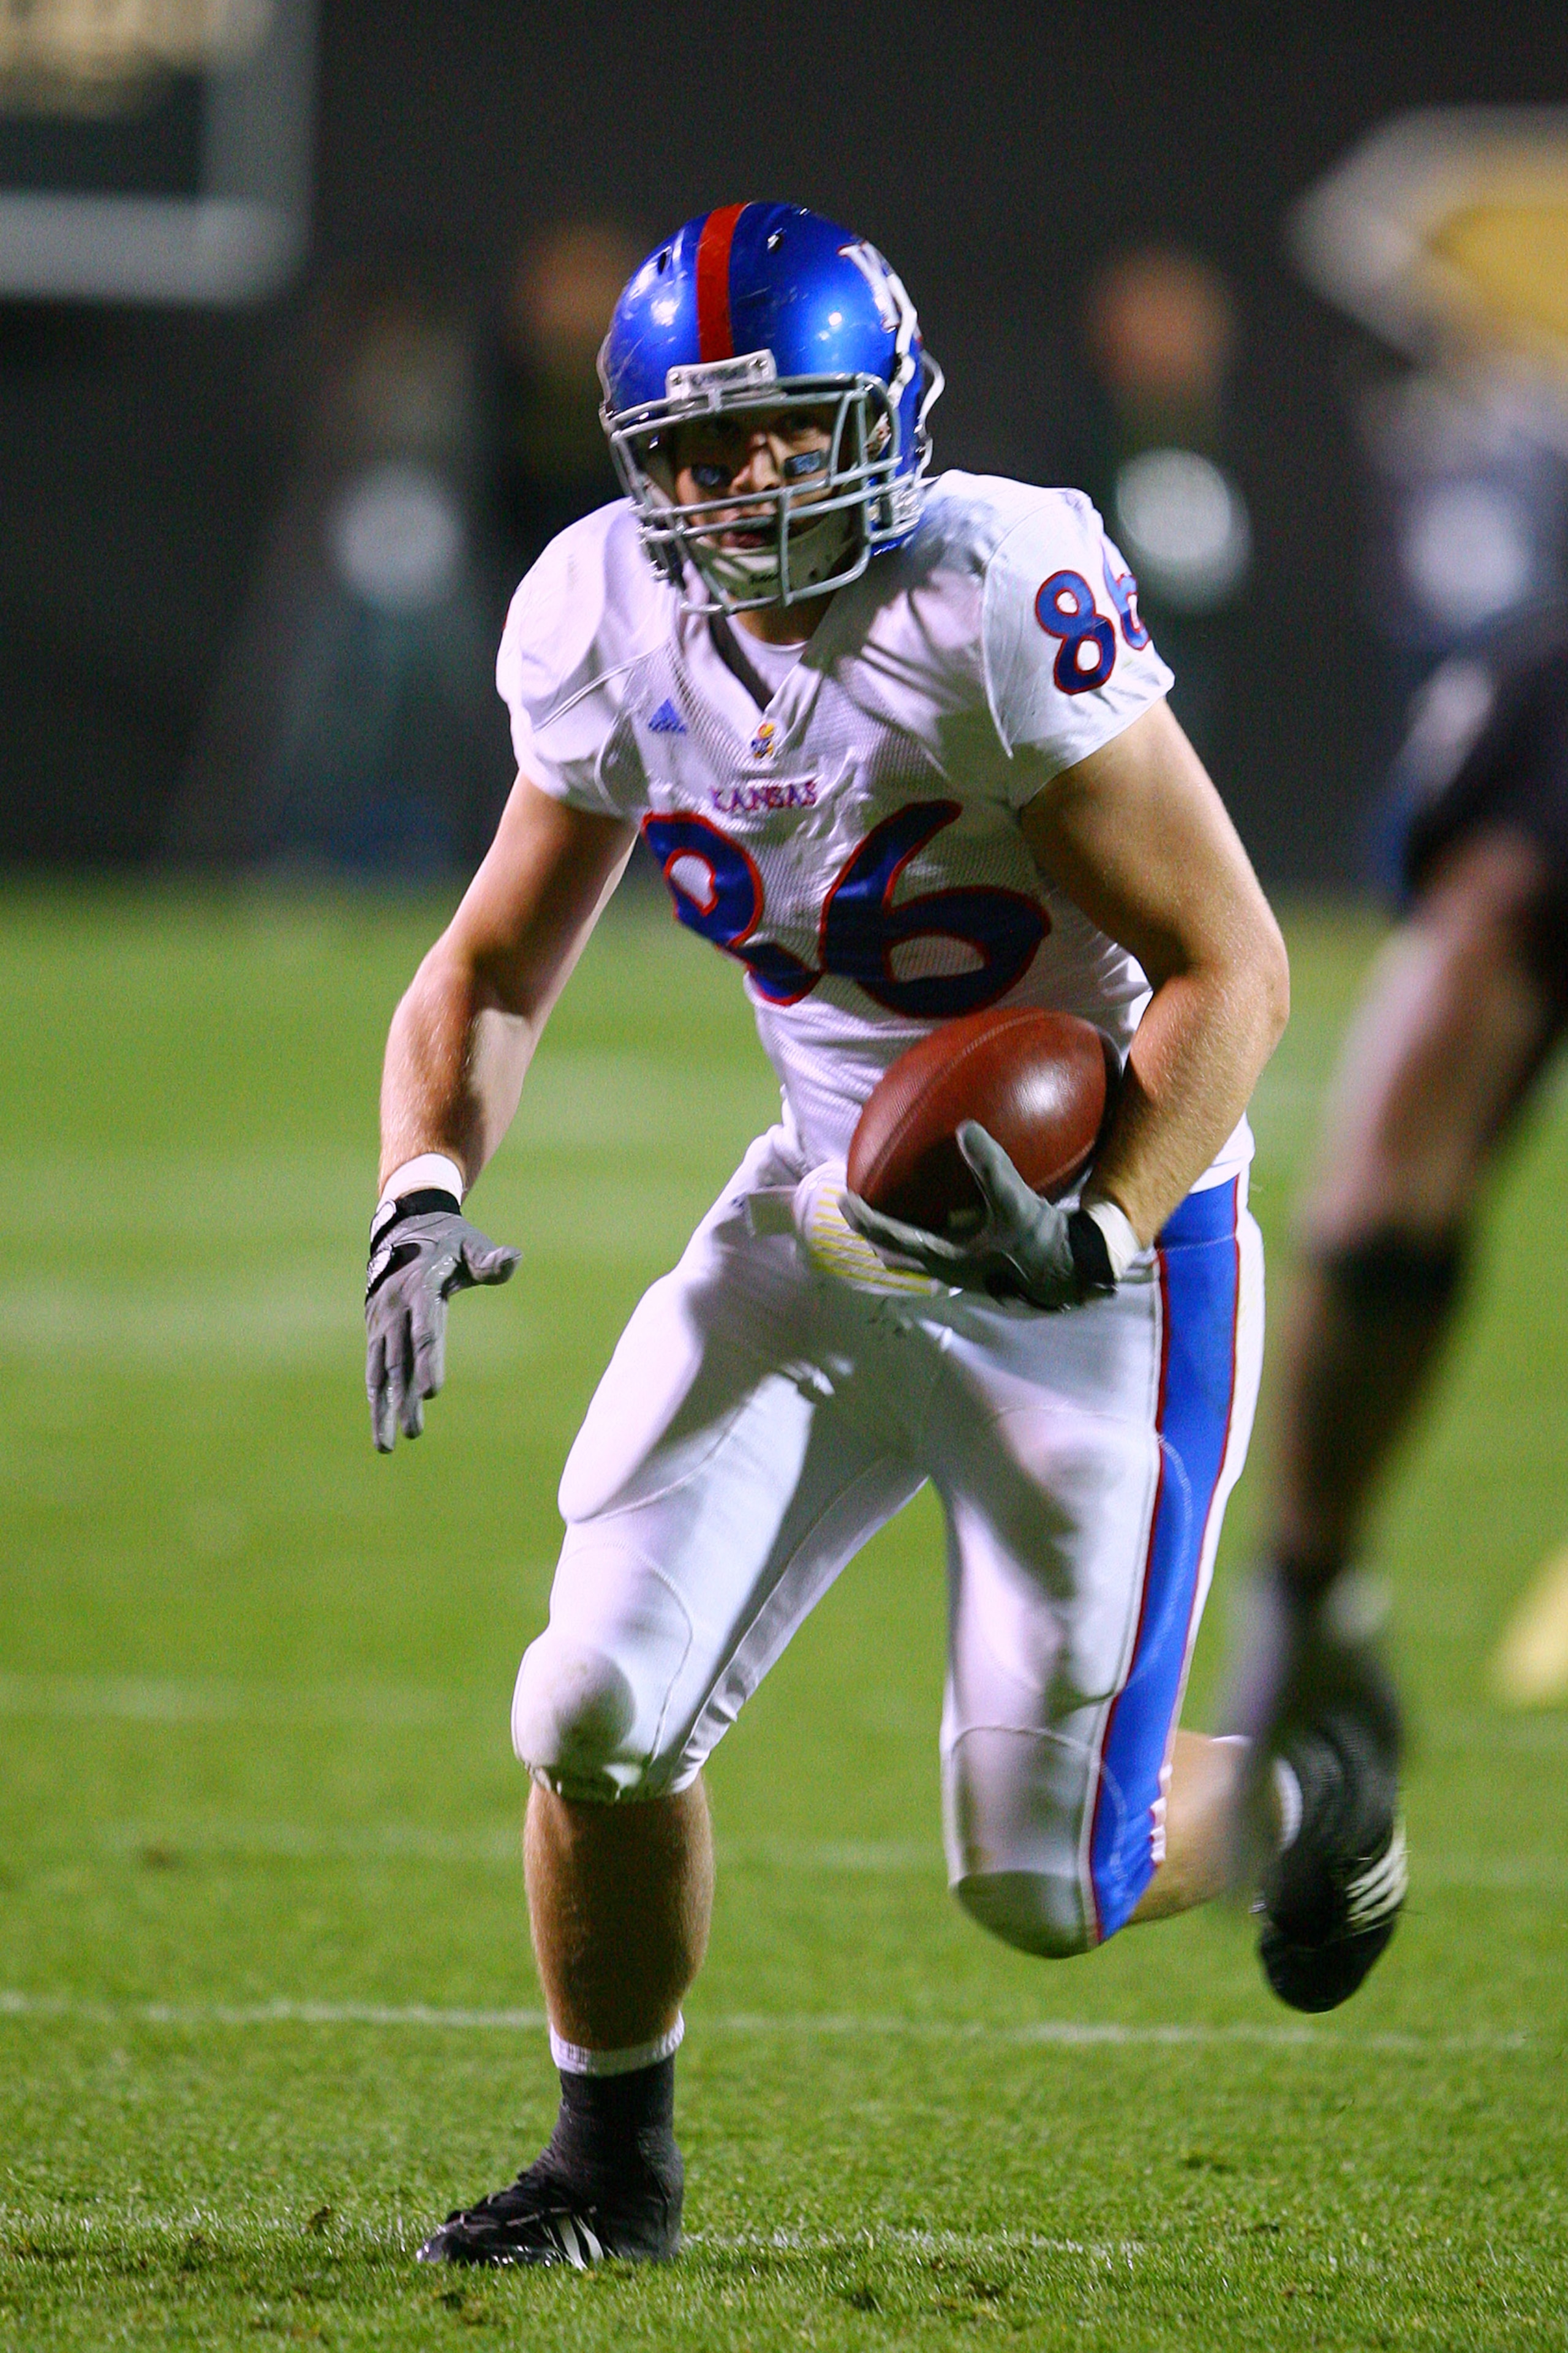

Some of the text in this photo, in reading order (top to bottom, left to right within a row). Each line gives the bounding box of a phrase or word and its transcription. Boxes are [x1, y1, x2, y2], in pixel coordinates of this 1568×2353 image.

[1035, 538, 1151, 695] 86
[709, 780, 817, 813] KANSAS
[641, 799, 1052, 1019] 86
